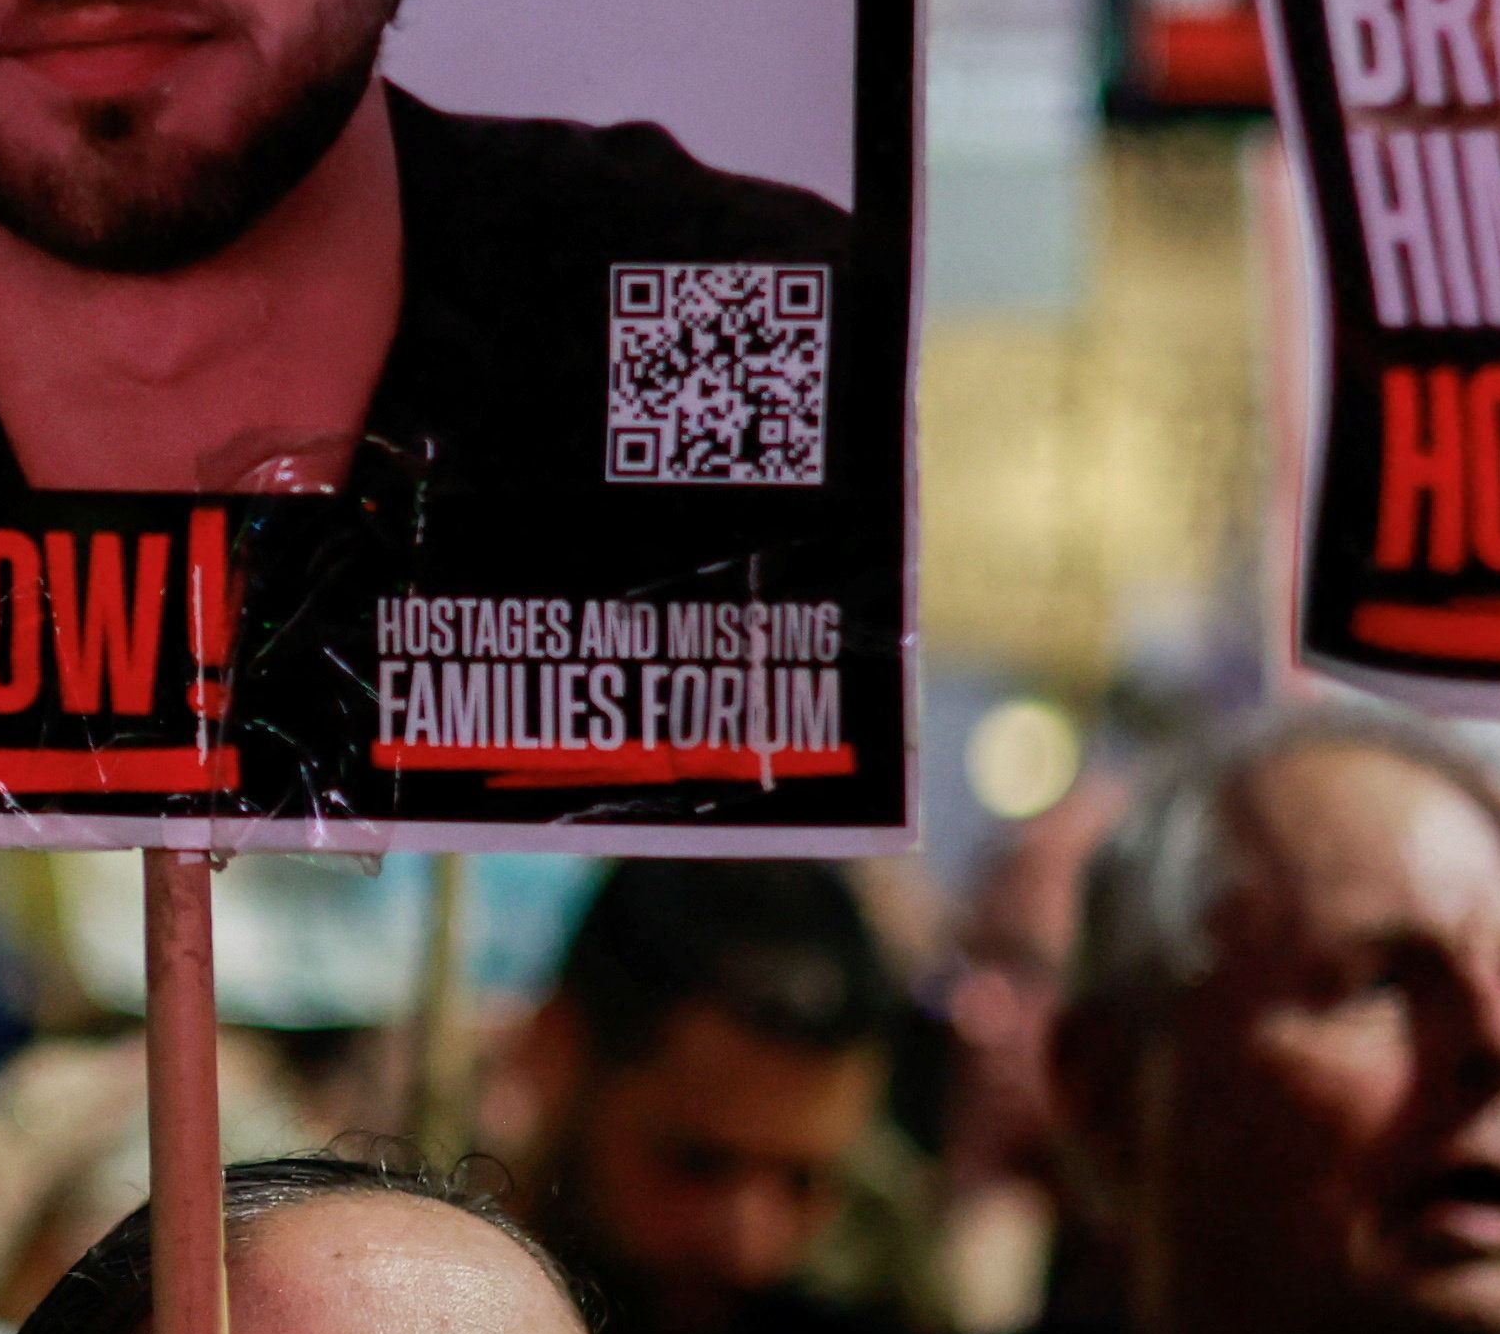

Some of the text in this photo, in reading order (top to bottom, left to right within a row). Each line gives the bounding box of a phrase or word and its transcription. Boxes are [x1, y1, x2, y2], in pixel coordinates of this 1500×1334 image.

[377, 596, 842, 663] HOSTAGES AND MISSING
[377, 660, 842, 754] FAMILIES FORUM
